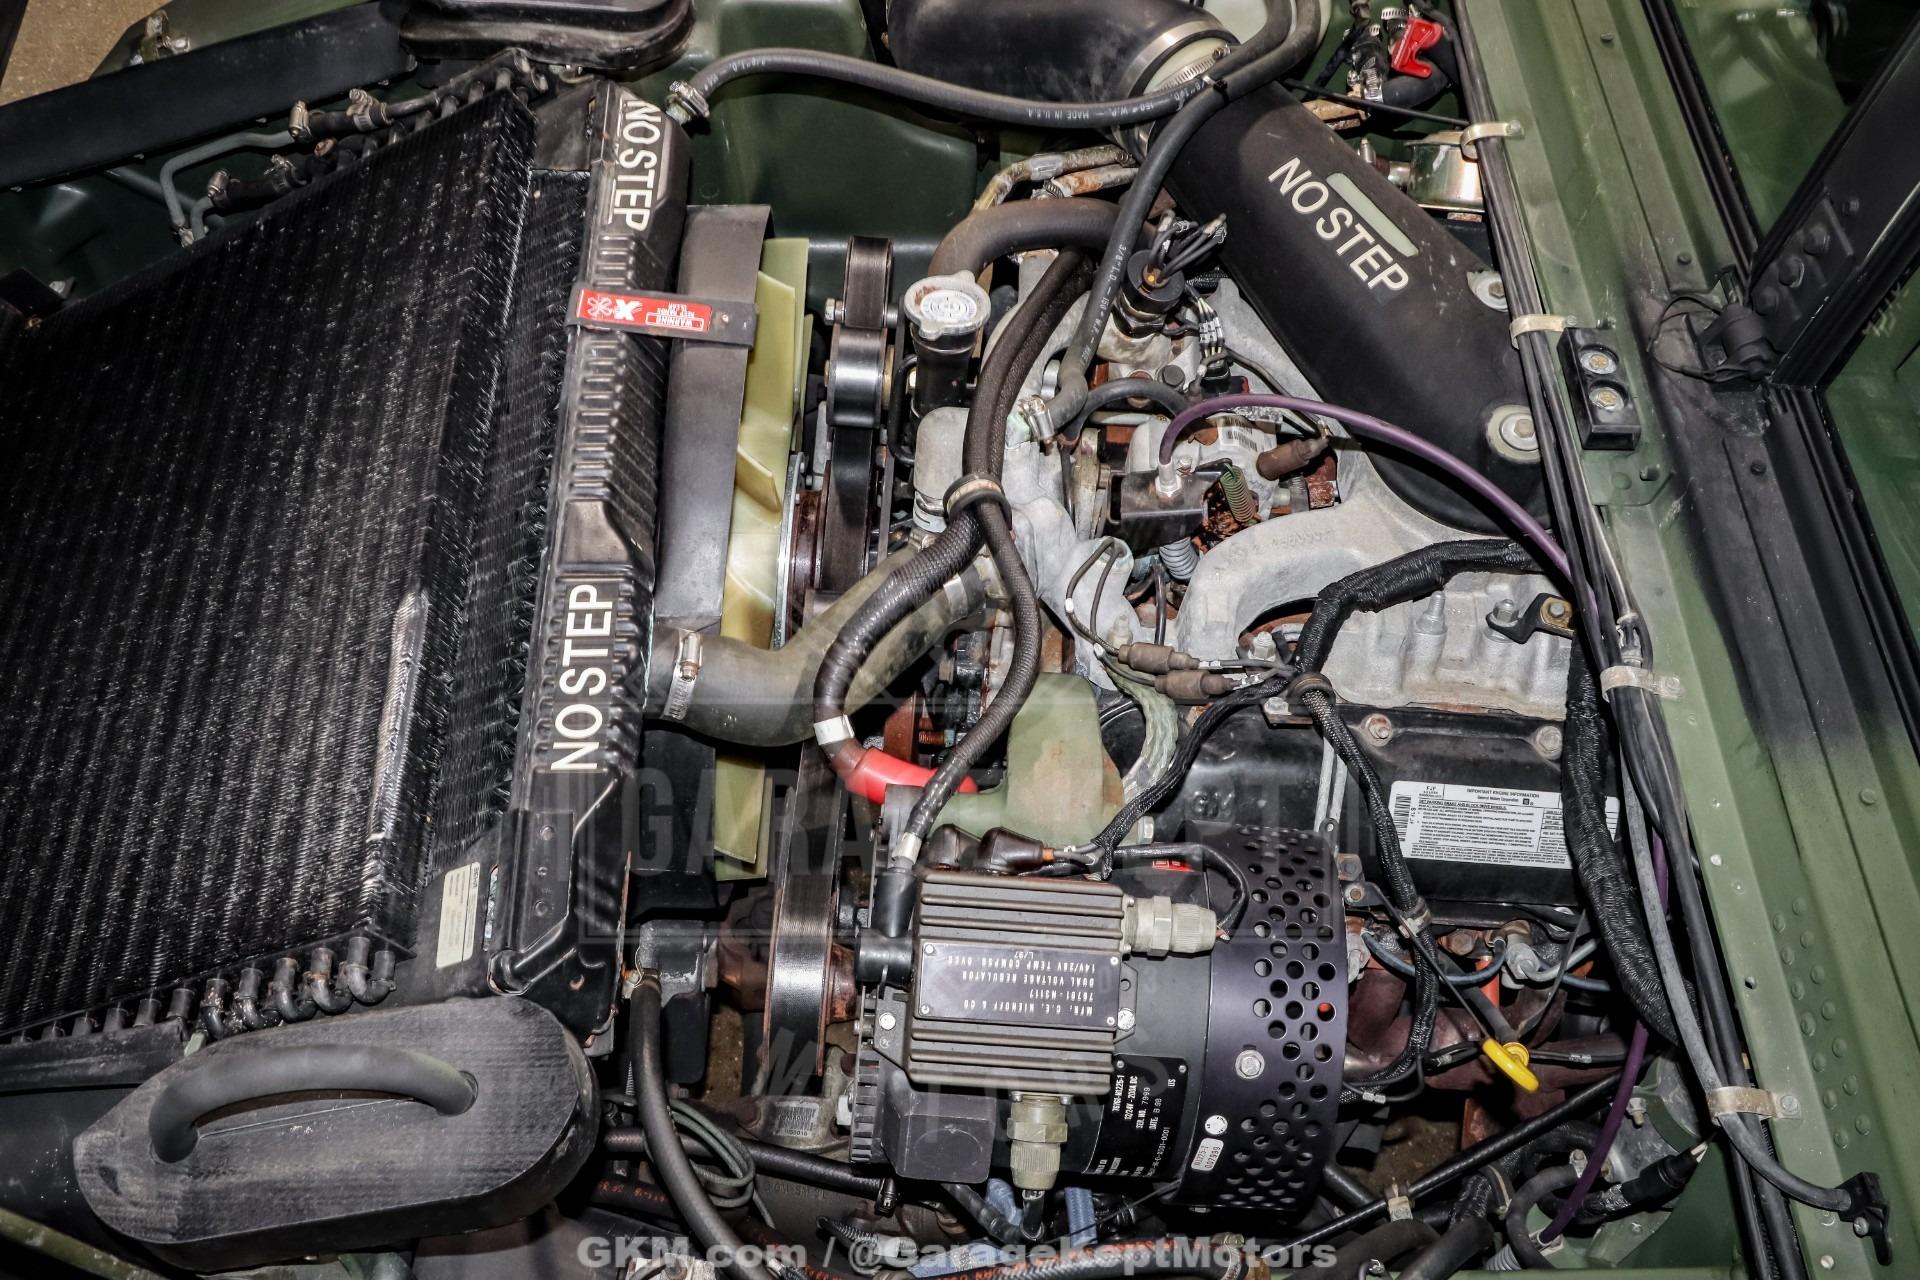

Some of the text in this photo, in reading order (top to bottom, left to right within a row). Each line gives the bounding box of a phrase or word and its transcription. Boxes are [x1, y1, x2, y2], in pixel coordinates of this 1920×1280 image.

[1054, 110, 1063, 119] IN
[1066, 110, 1090, 120] MADE
[613, 100, 662, 232] NO STEP
[1268, 157, 1409, 291] NO STEP
[550, 584, 612, 770] NO STEP
[1026, 960, 1051, 971] TEMP
[962, 970, 1094, 988] DUAL VOLTAGE REGULATOR
[994, 1001, 1034, 1014] NIEHOFF
[1069, 1005, 1093, 1016] MFR:
[1168, 1078, 1175, 1088] US
